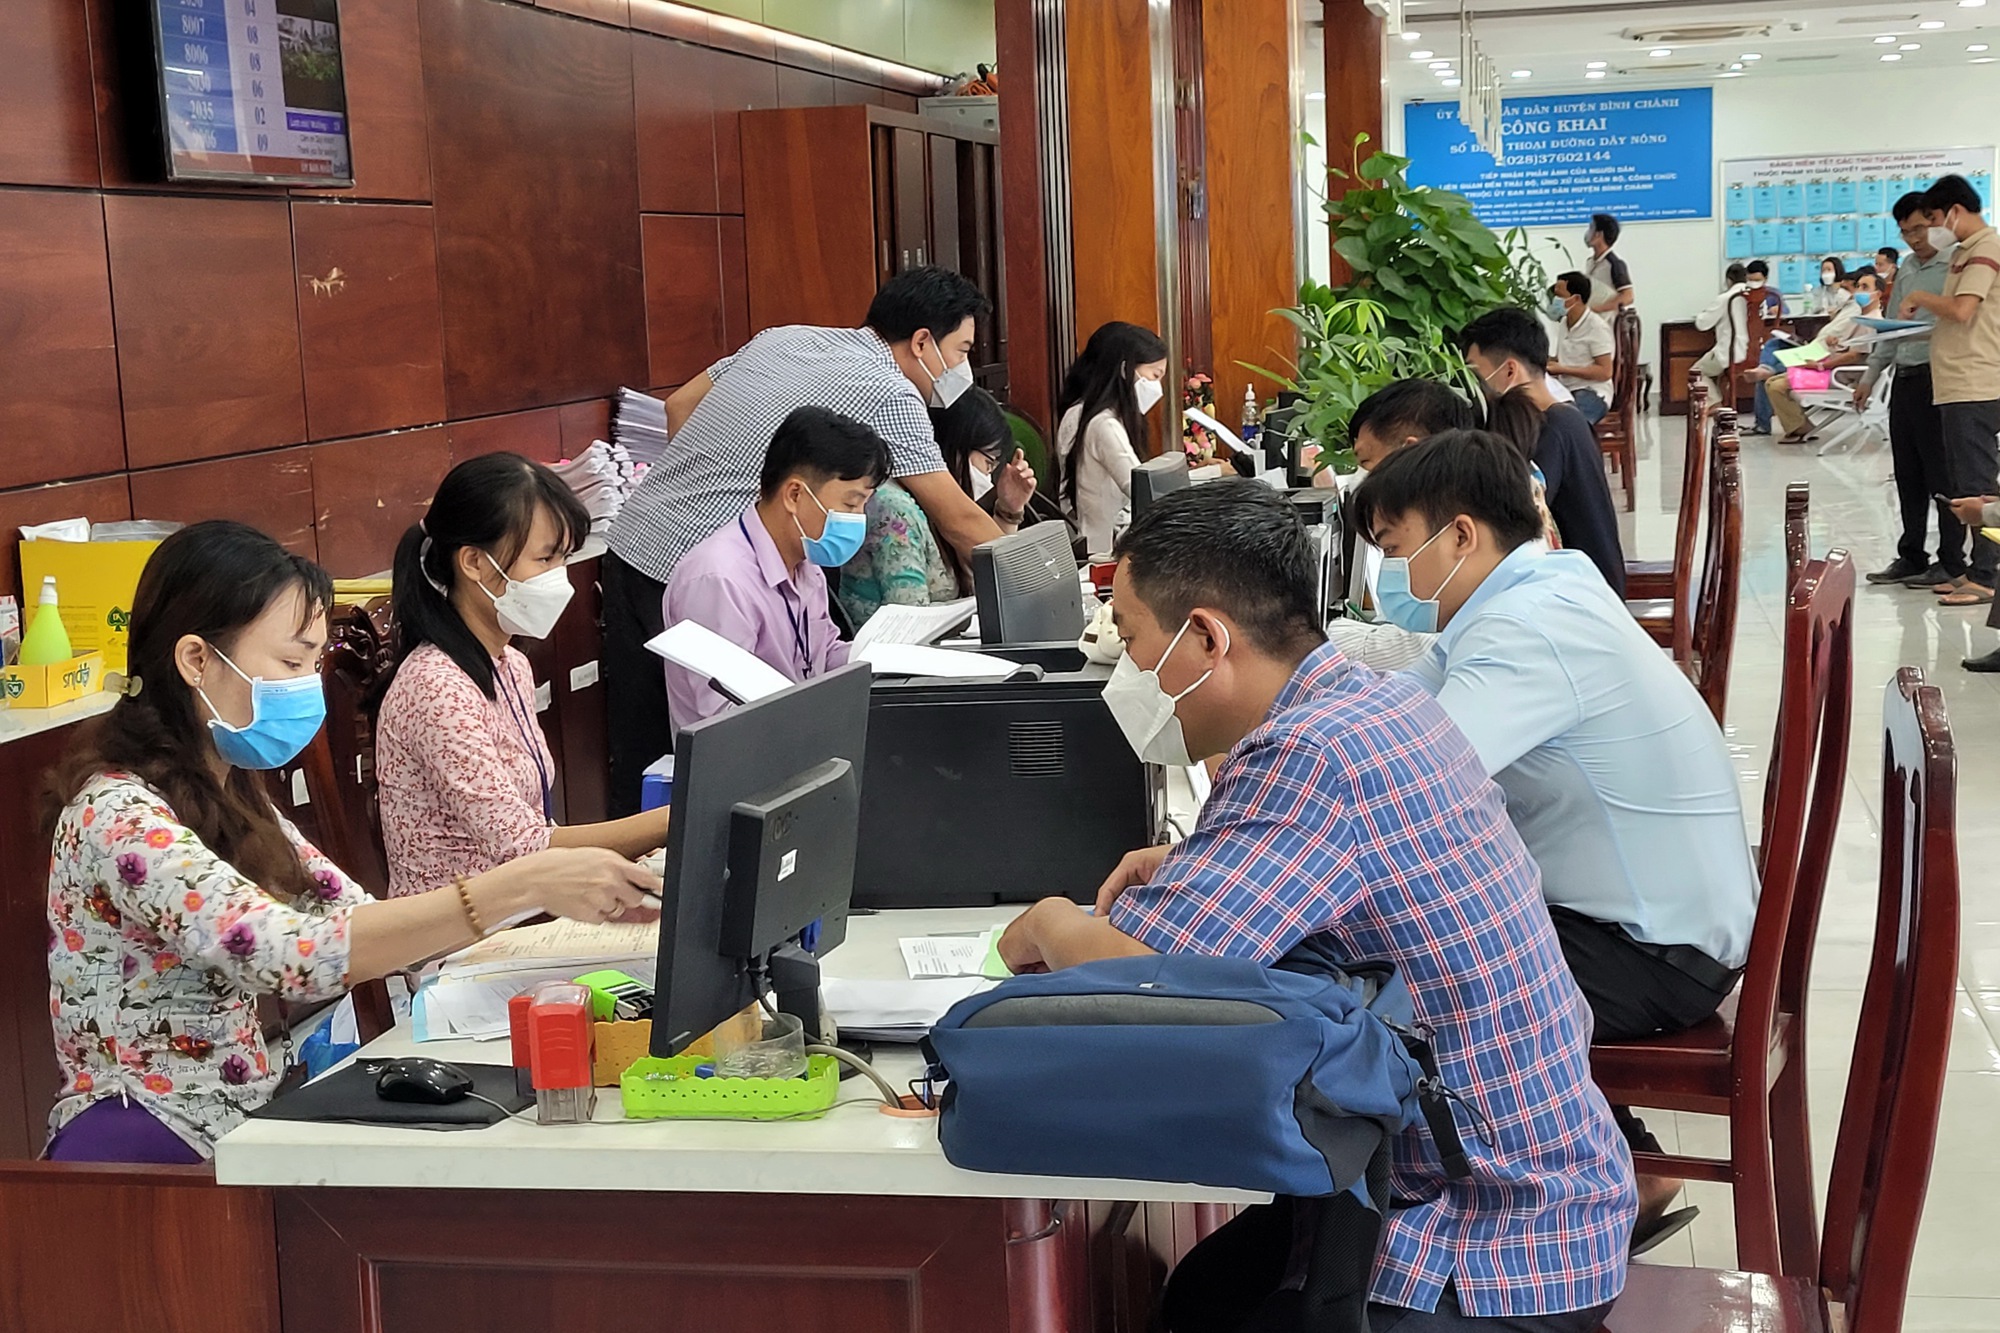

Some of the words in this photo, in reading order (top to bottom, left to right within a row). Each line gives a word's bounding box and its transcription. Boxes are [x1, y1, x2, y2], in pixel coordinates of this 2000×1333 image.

[182, 15, 205, 36] 8007
[247, 25, 259, 45] 08
[184, 43, 209, 65] 8006
[249, 52, 261, 72] 08
[252, 79, 264, 98] 06
[254, 106, 266, 125] 02
[1523, 104, 1550, 116] DÂN
[1501, 118, 1552, 135] CÔNG
[1557, 117, 1608, 132] KHAI
[257, 133, 269, 152] 09
[1450, 141, 1468, 154] SỐ
[1503, 151, 1611, 166] (028)37602144
